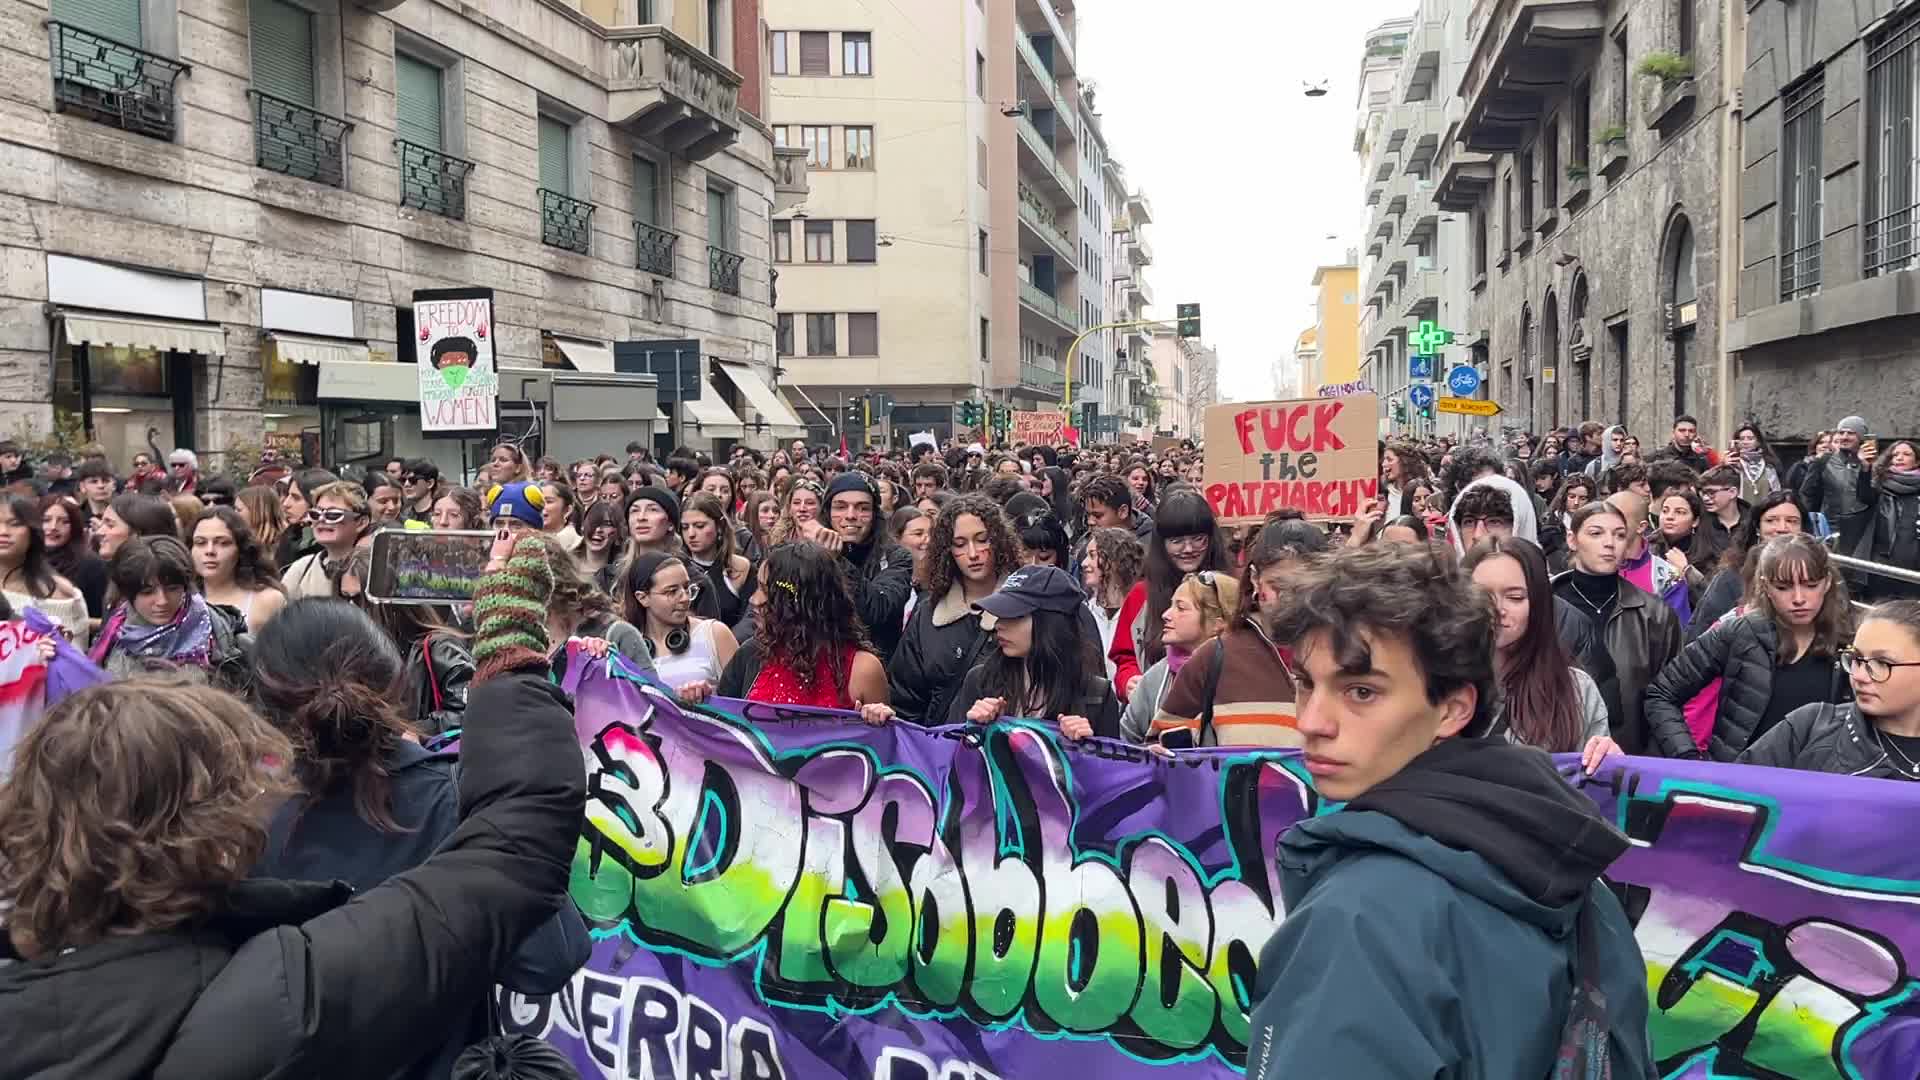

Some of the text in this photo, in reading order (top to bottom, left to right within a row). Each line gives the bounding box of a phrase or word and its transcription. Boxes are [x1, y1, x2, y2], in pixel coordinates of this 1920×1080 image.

[417, 302, 488, 328] FREEDOM
[447, 325, 460, 336] TO
[422, 396, 490, 426] WOMEN
[1017, 420, 1032, 432] ME
[1234, 402, 1345, 455] FUCK
[1260, 452, 1317, 481] the
[1205, 478, 1377, 518] PATRIARCHY
